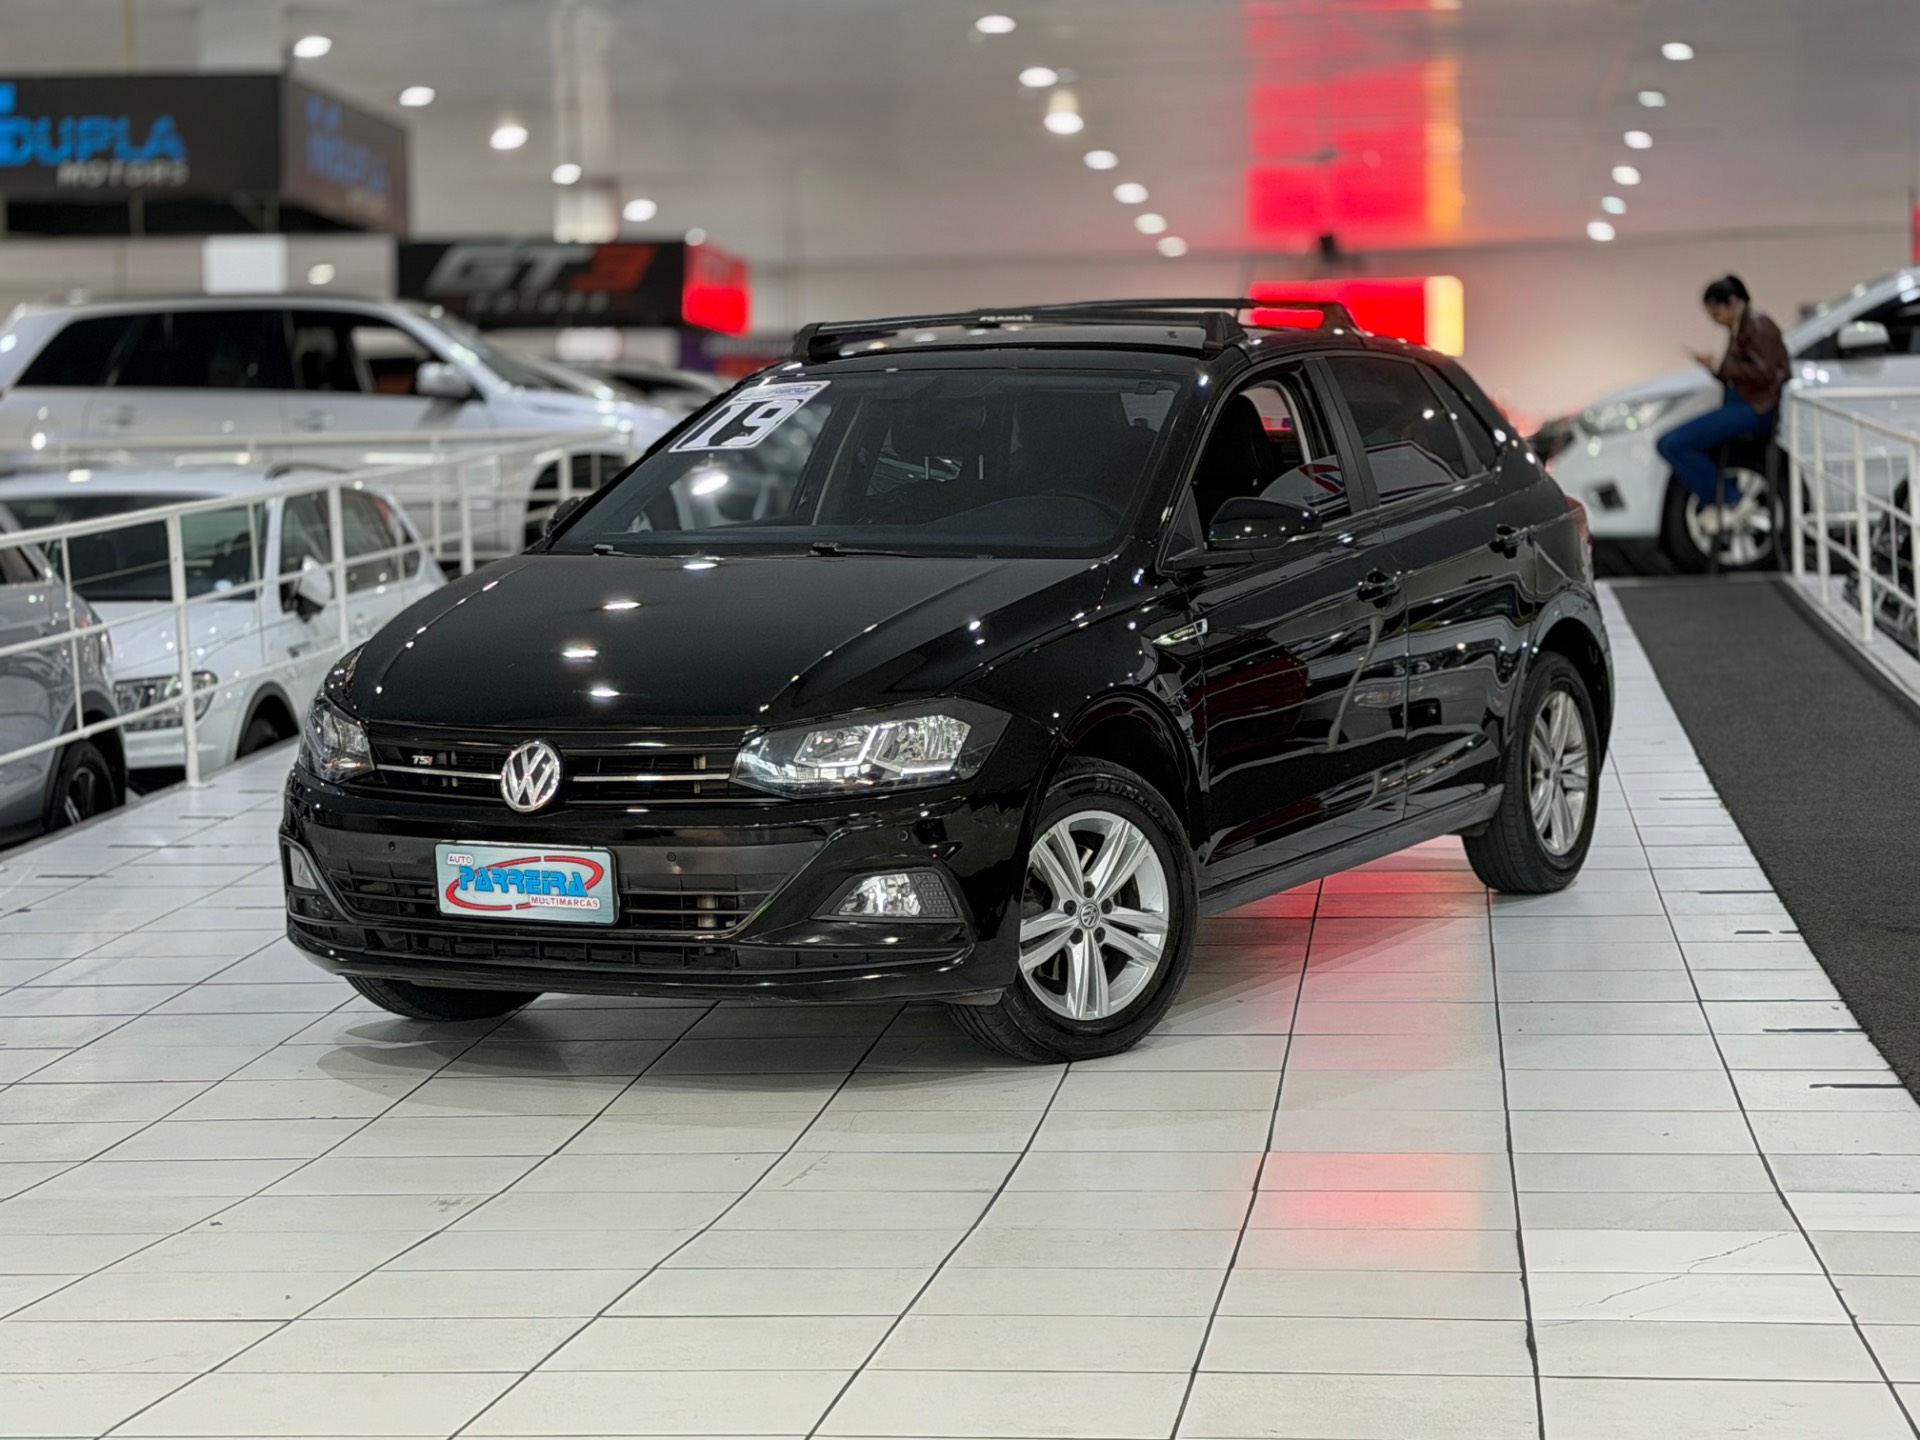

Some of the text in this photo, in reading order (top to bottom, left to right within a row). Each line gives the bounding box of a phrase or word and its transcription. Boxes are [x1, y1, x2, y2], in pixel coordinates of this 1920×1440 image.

[680, 399, 800, 449] 19
[449, 854, 473, 865] AUTO
[530, 896, 599, 909] MULTIMARCAS
